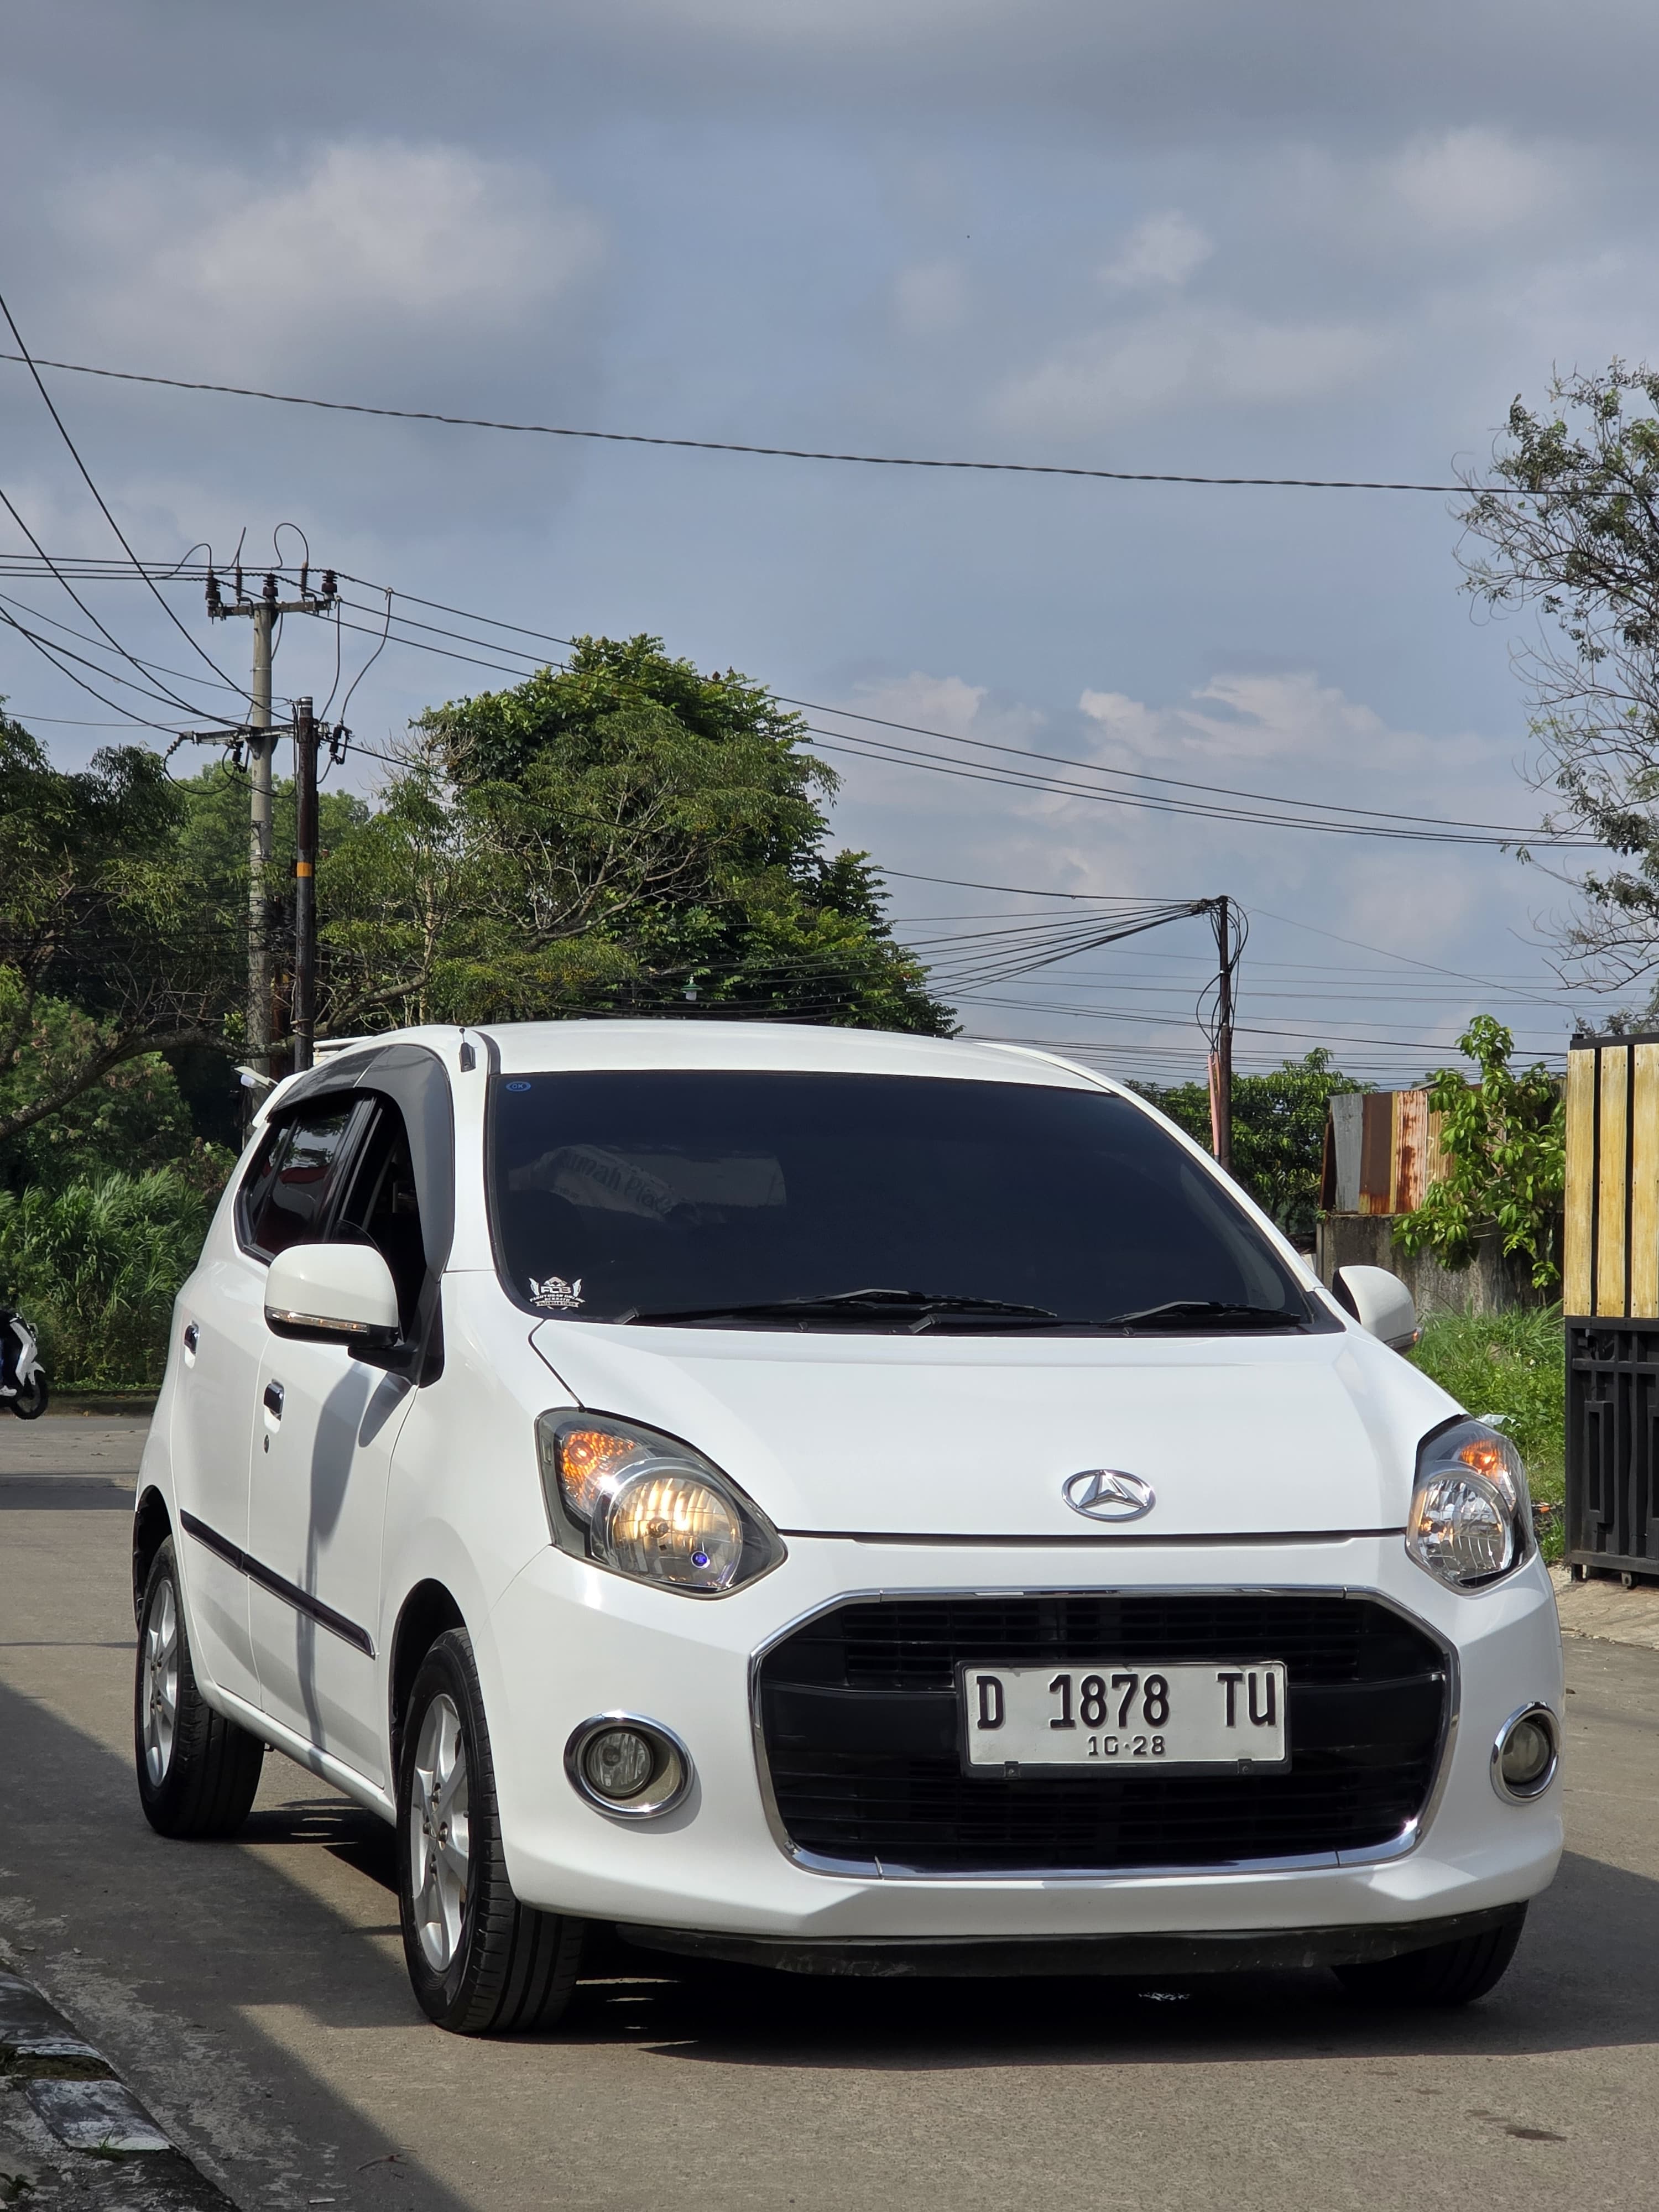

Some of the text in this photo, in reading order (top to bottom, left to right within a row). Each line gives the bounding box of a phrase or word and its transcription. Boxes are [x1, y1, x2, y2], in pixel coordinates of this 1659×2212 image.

[976, 1675, 1004, 1729] D
[1049, 1674, 1170, 1728] 1878
[1217, 1672, 1276, 1727] TU
